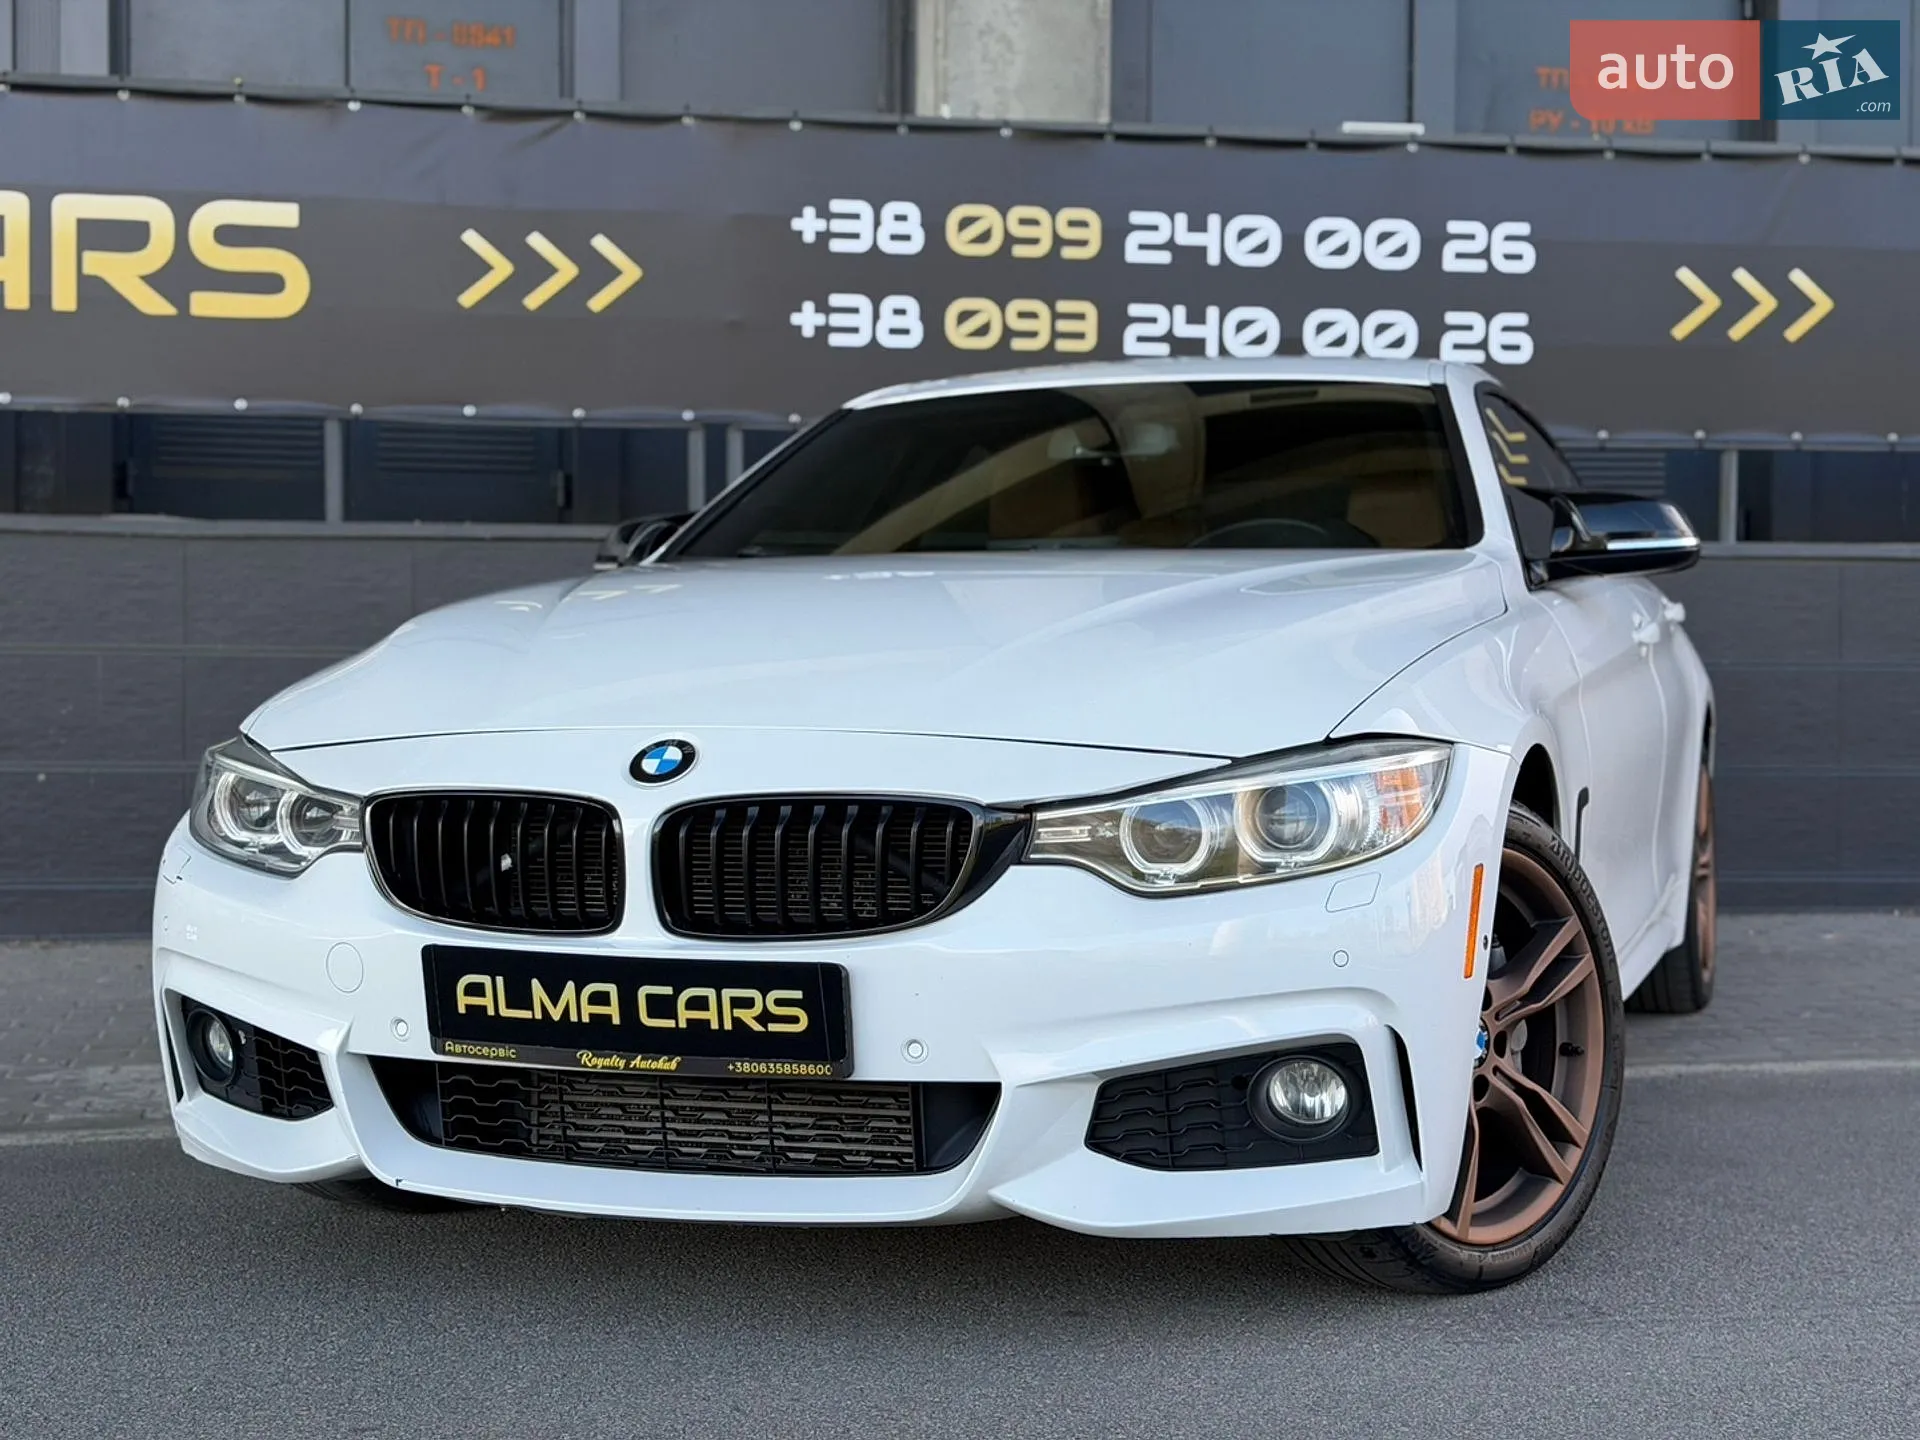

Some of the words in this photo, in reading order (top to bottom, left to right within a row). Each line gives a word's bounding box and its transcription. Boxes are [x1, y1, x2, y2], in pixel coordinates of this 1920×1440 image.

[0, 190, 310, 318] RS
[791, 199, 925, 255] +38
[945, 204, 1102, 260] 099
[1124, 210, 1282, 268] 240
[1304, 216, 1421, 270] 00
[1441, 219, 1537, 274] 26
[790, 293, 924, 349] +38
[944, 298, 1098, 353] 093
[1123, 303, 1280, 358] 240
[1302, 308, 1419, 358] 00
[1439, 311, 1534, 364] 26
[456, 974, 620, 1026] ALMA
[637, 984, 809, 1033] CARS
[445, 1041, 517, 1059] Автосервіс
[576, 1049, 627, 1070] Royalty
[630, 1056, 681, 1071] Autohub
[727, 1062, 832, 1076] +380635858600
